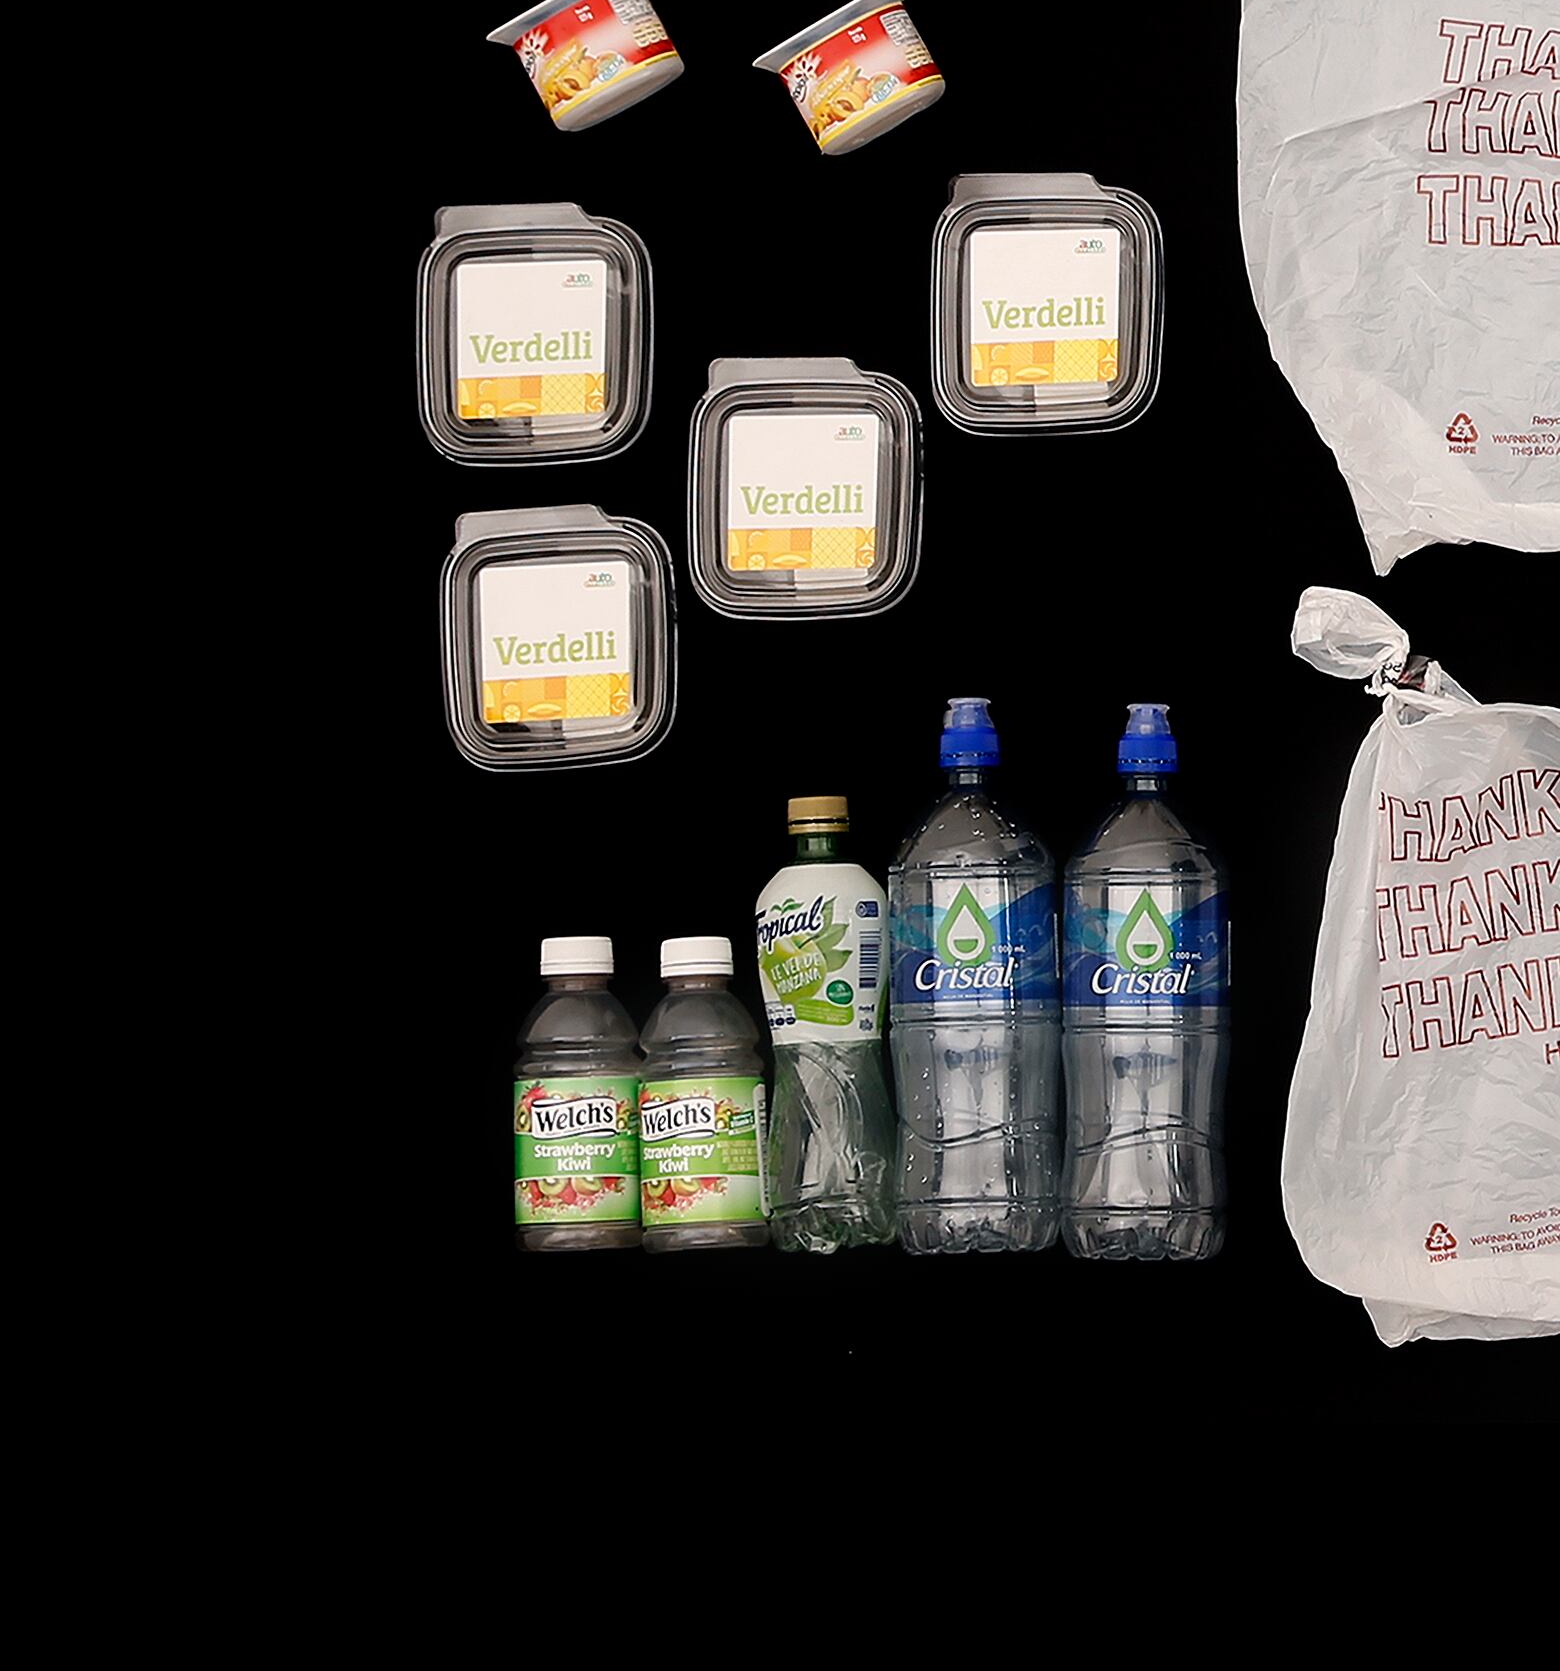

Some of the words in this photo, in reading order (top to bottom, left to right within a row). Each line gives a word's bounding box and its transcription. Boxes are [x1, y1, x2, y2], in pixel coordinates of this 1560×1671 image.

[983, 296, 1106, 330] Verdelli
[470, 330, 593, 364] Verdelli
[741, 484, 863, 516] Verdelli
[493, 630, 617, 666] Verdelli
[914, 956, 1015, 991] Cristal
[1091, 963, 1192, 995] Cristal
[534, 1103, 614, 1132] Welch's
[643, 1102, 712, 1134] Welch's
[534, 1142, 616, 1158] Strawberry
[557, 1157, 592, 1172] Kiwi
[643, 1143, 715, 1161] Strawberry
[658, 1158, 689, 1173] Kiwi
